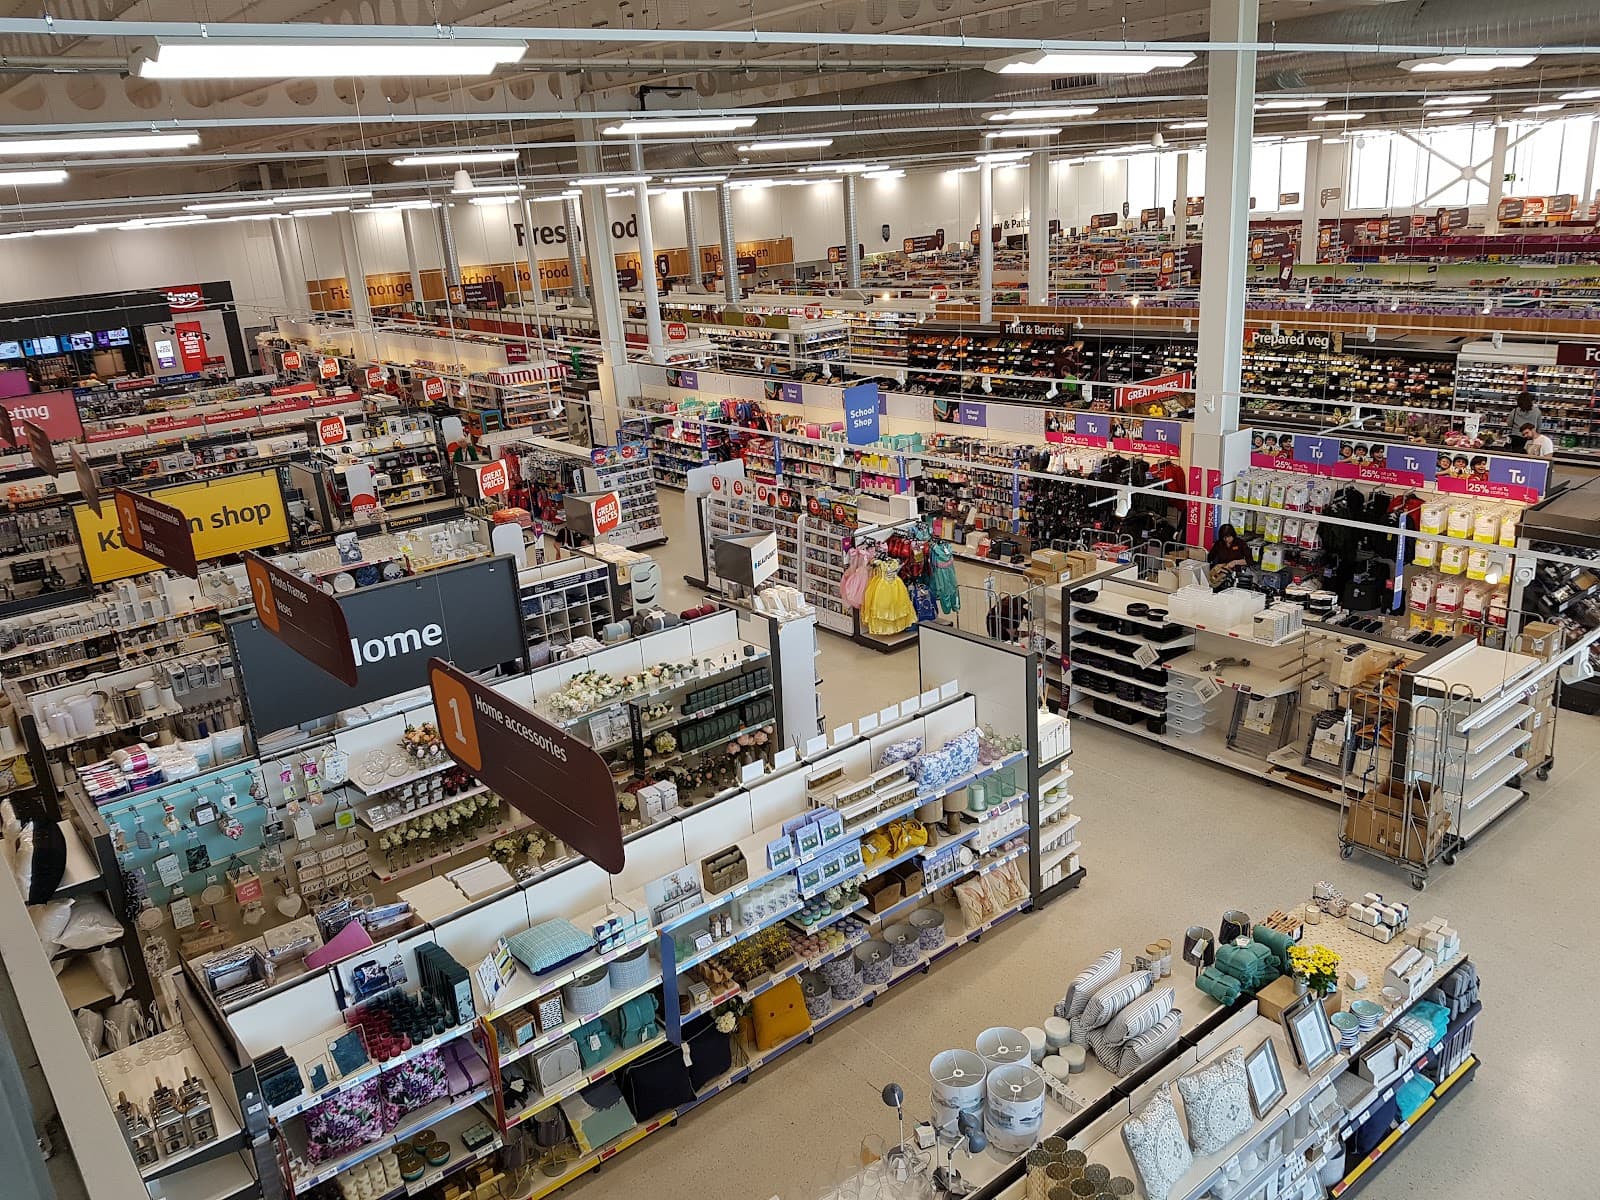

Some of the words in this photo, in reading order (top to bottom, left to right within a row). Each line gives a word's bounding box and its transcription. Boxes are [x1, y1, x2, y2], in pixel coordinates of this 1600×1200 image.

[611, 213, 638, 239] od
[904, 241, 914, 251] 22
[1253, 243, 1263, 255] 40
[705, 247, 769, 264] Deltessen
[829, 251, 839, 259] 21
[1163, 256, 1172, 268] 41
[512, 268, 531, 282] Ho
[539, 265, 570, 280] Food
[167, 291, 199, 304] Argos
[450, 289, 463, 302] 18
[1005, 323, 1024, 335] Fruit
[1025, 324, 1033, 335] &
[1034, 324, 1065, 337] Berries
[1251, 331, 1305, 347] Prepared
[1307, 336, 1330, 350] veg
[426, 386, 443, 396] PRICES
[427, 382, 442, 390] GREAT
[1127, 387, 1151, 401] GREAT
[8, 405, 49, 422] eting
[850, 405, 875, 419] School
[321, 421, 341, 432] GREAT
[854, 417, 873, 429] Shop
[1087, 422, 1098, 434] Tu
[321, 428, 343, 439] PRICES
[1155, 429, 1168, 442] Tu
[1309, 445, 1323, 459] Tu
[1275, 459, 1293, 470] 25%
[1404, 456, 1419, 471] Tu
[482, 468, 503, 483] GREAT
[1361, 468, 1380, 480] 25%
[1508, 469, 1526, 484] Tu
[482, 477, 505, 490] PRICES
[1468, 482, 1489, 495] 25%
[353, 503, 375, 512] GREAT
[596, 501, 617, 517] GREAT
[123, 507, 135, 535] 3
[210, 503, 272, 529] shop
[390, 516, 422, 527] Dinnerware
[595, 510, 618, 526] PRICES
[1190, 508, 1198, 526] 25%
[300, 535, 331, 546] Glassware
[269, 572, 288, 594] Photo
[287, 581, 309, 604] frames
[256, 577, 270, 615] 2
[275, 598, 293, 618] Vases
[449, 697, 467, 745] 1
[474, 693, 503, 725] Home
[505, 714, 568, 763] accessories
